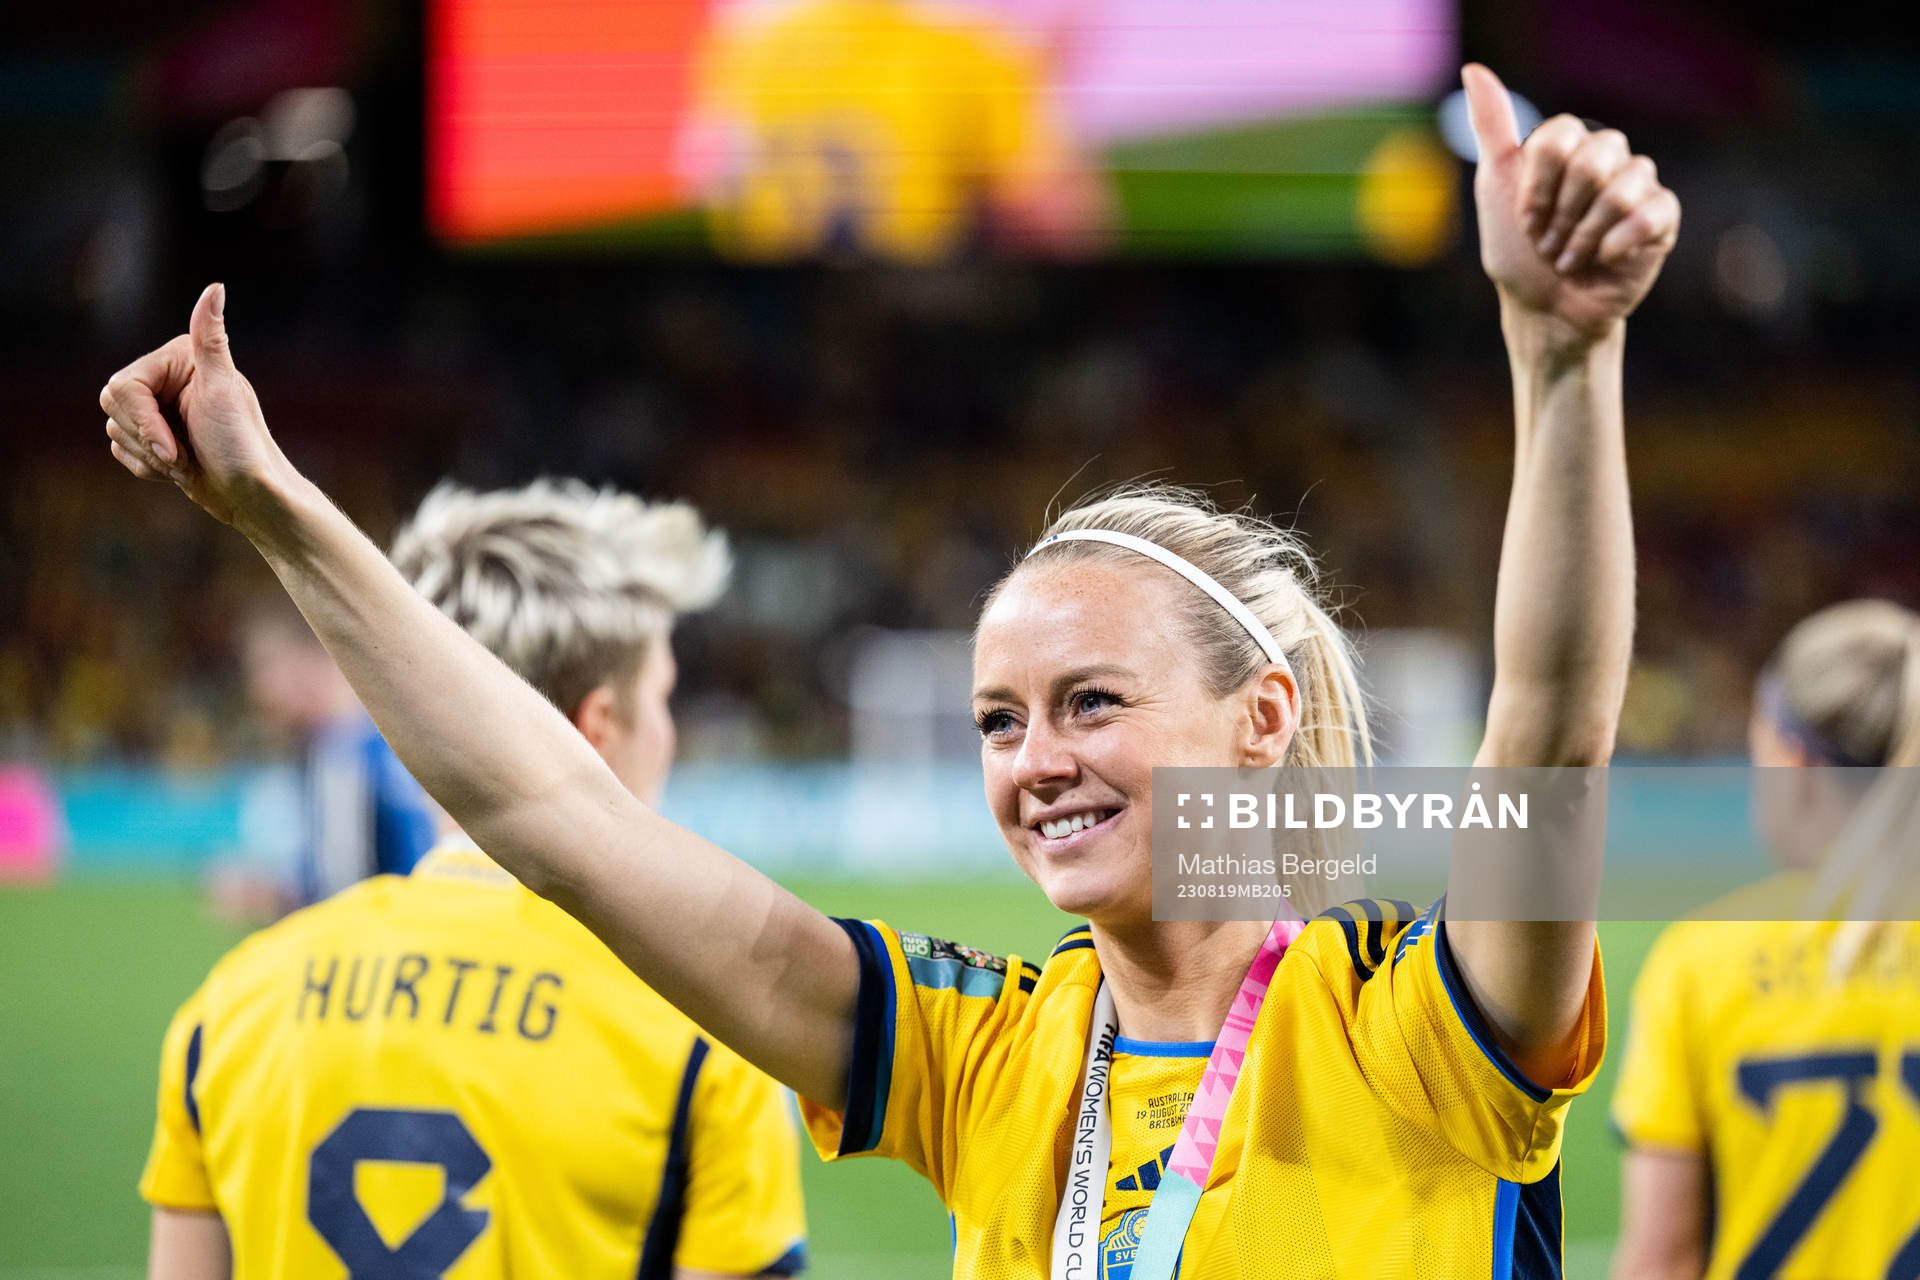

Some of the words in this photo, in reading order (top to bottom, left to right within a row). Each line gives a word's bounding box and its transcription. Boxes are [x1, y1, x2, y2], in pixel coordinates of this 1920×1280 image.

[297, 952, 565, 1043] HURTIG
[1094, 1023, 1115, 1062] FIFA
[1076, 1065, 1109, 1165] WOMEN'S
[1136, 1110, 1147, 1120] 19
[1150, 1104, 1177, 1119] AUGUST
[1148, 1092, 1195, 1109] AUSTRALIA
[1068, 1169, 1090, 1248] WORLD
